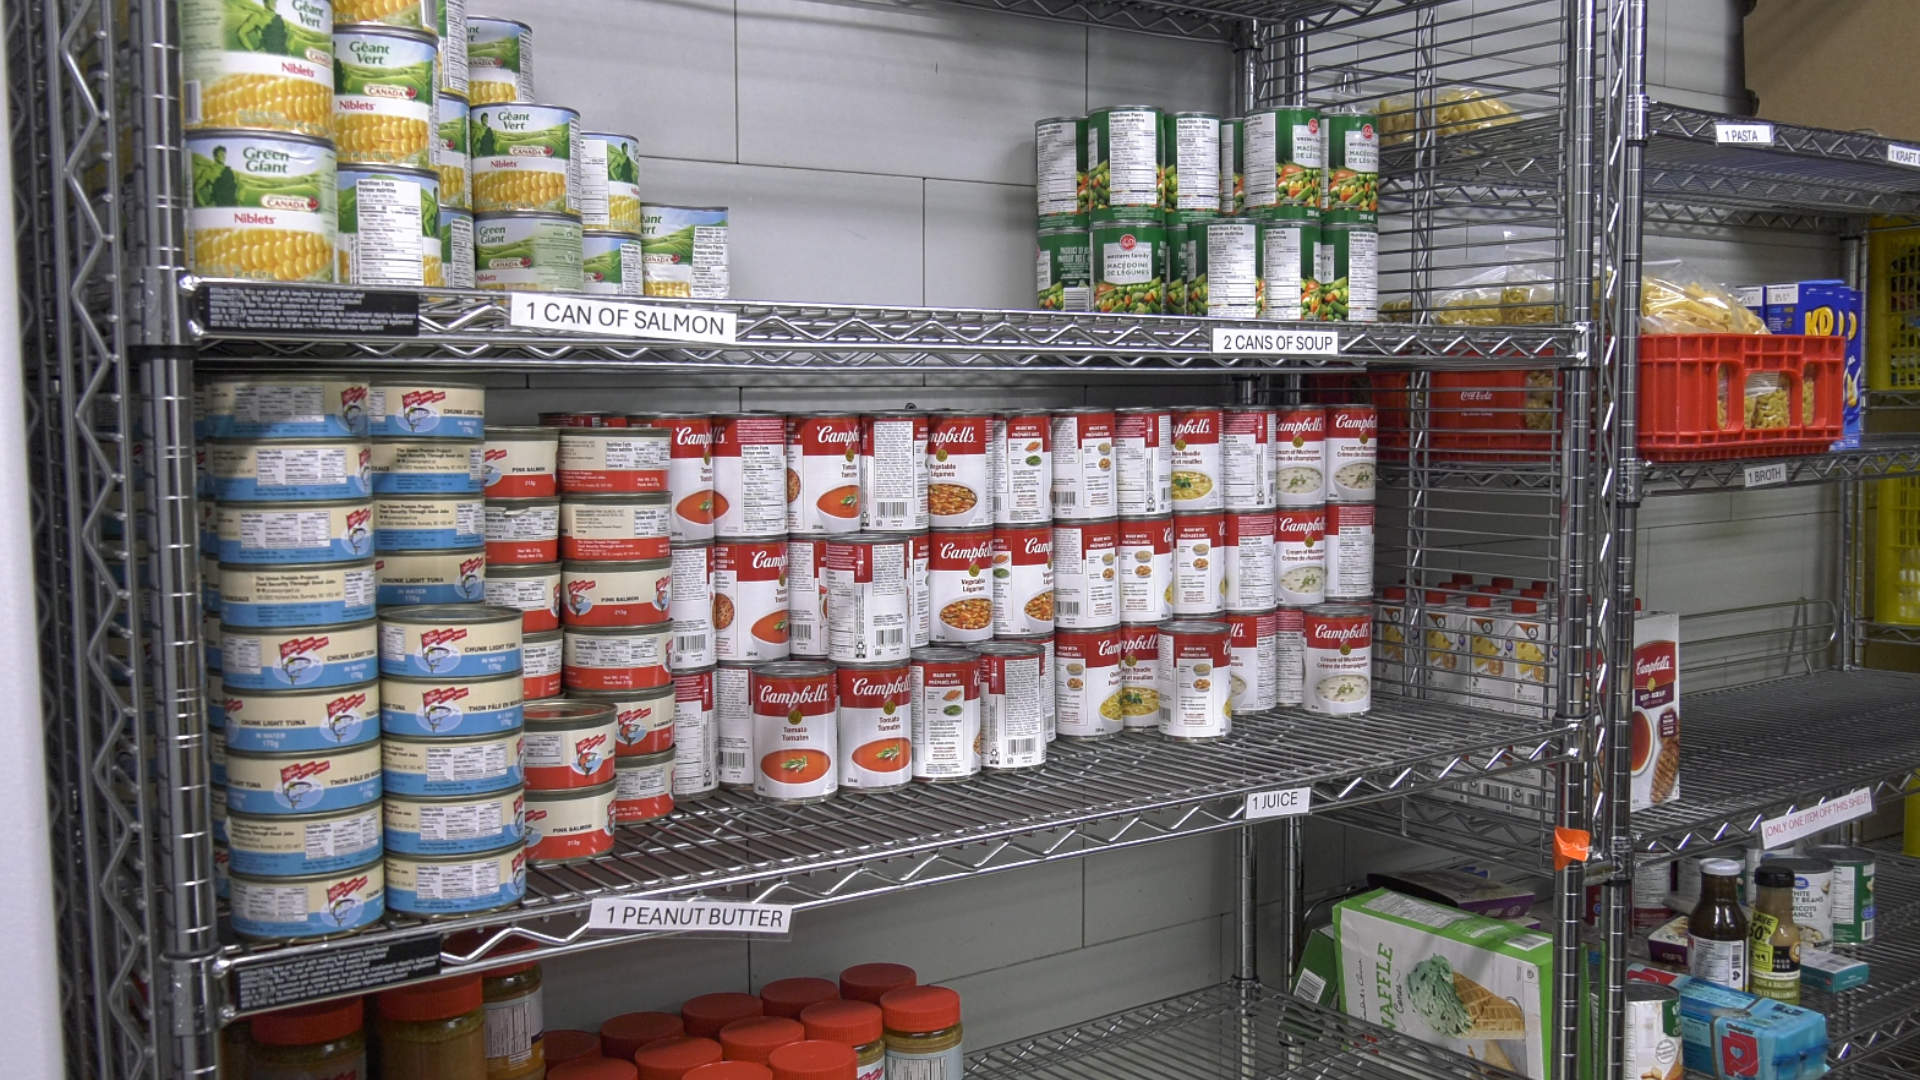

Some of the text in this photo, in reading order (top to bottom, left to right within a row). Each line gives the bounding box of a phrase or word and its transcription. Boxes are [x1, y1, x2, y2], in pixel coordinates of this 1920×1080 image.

[299, 12, 321, 29] Vert
[349, 41, 391, 55] Géant
[356, 53, 385, 65] Vert
[281, 62, 315, 78] Niblets
[368, 88, 404, 97] CANADA
[339, 100, 375, 111] Niblets
[497, 111, 531, 121] Géant
[502, 121, 526, 130] Vert
[1725, 130, 1759, 143] 1 PASTA
[242, 146, 290, 162] Green
[512, 148, 543, 156] CANADA
[1896, 150, 1917, 164] KRAFT
[245, 159, 288, 174] Giant
[490, 159, 518, 168] Niblets
[266, 199, 306, 209] CANADA
[234, 213, 275, 225] Niblets
[479, 225, 506, 236] Green
[642, 224, 657, 235] ert
[480, 234, 505, 245] Giant
[490, 261, 521, 269] CANADA
[643, 256, 670, 264] CANADA
[1106, 261, 1149, 270] MACÉDOINE
[476, 273, 497, 283] Niblets
[1116, 268, 1150, 277] LÉGUMES
[526, 302, 724, 336] 1 CAN OF SALMON
[1804, 306, 1835, 336] KD
[1223, 335, 1334, 351] 2 CANS OF SOUP
[1754, 467, 1782, 483] BROTH
[1314, 622, 1370, 642] Campbell's
[488, 644, 505, 652] LIGHT
[326, 654, 350, 662] CHUNK
[759, 683, 829, 708] Campbell's
[262, 719, 285, 727] LIGHT
[782, 734, 810, 742] Tomates
[330, 774, 364, 786] THON PÂLE
[1252, 791, 1299, 810] 1 JUICE
[1788, 816, 1805, 830] ONE
[1804, 810, 1820, 825] ITEM
[1819, 805, 1832, 818] OFF
[1832, 799, 1849, 813] THIS
[569, 823, 593, 833] SALMON
[606, 906, 783, 928] 1 PEANUT BUTTER
[1753, 911, 1774, 927] SAVE
